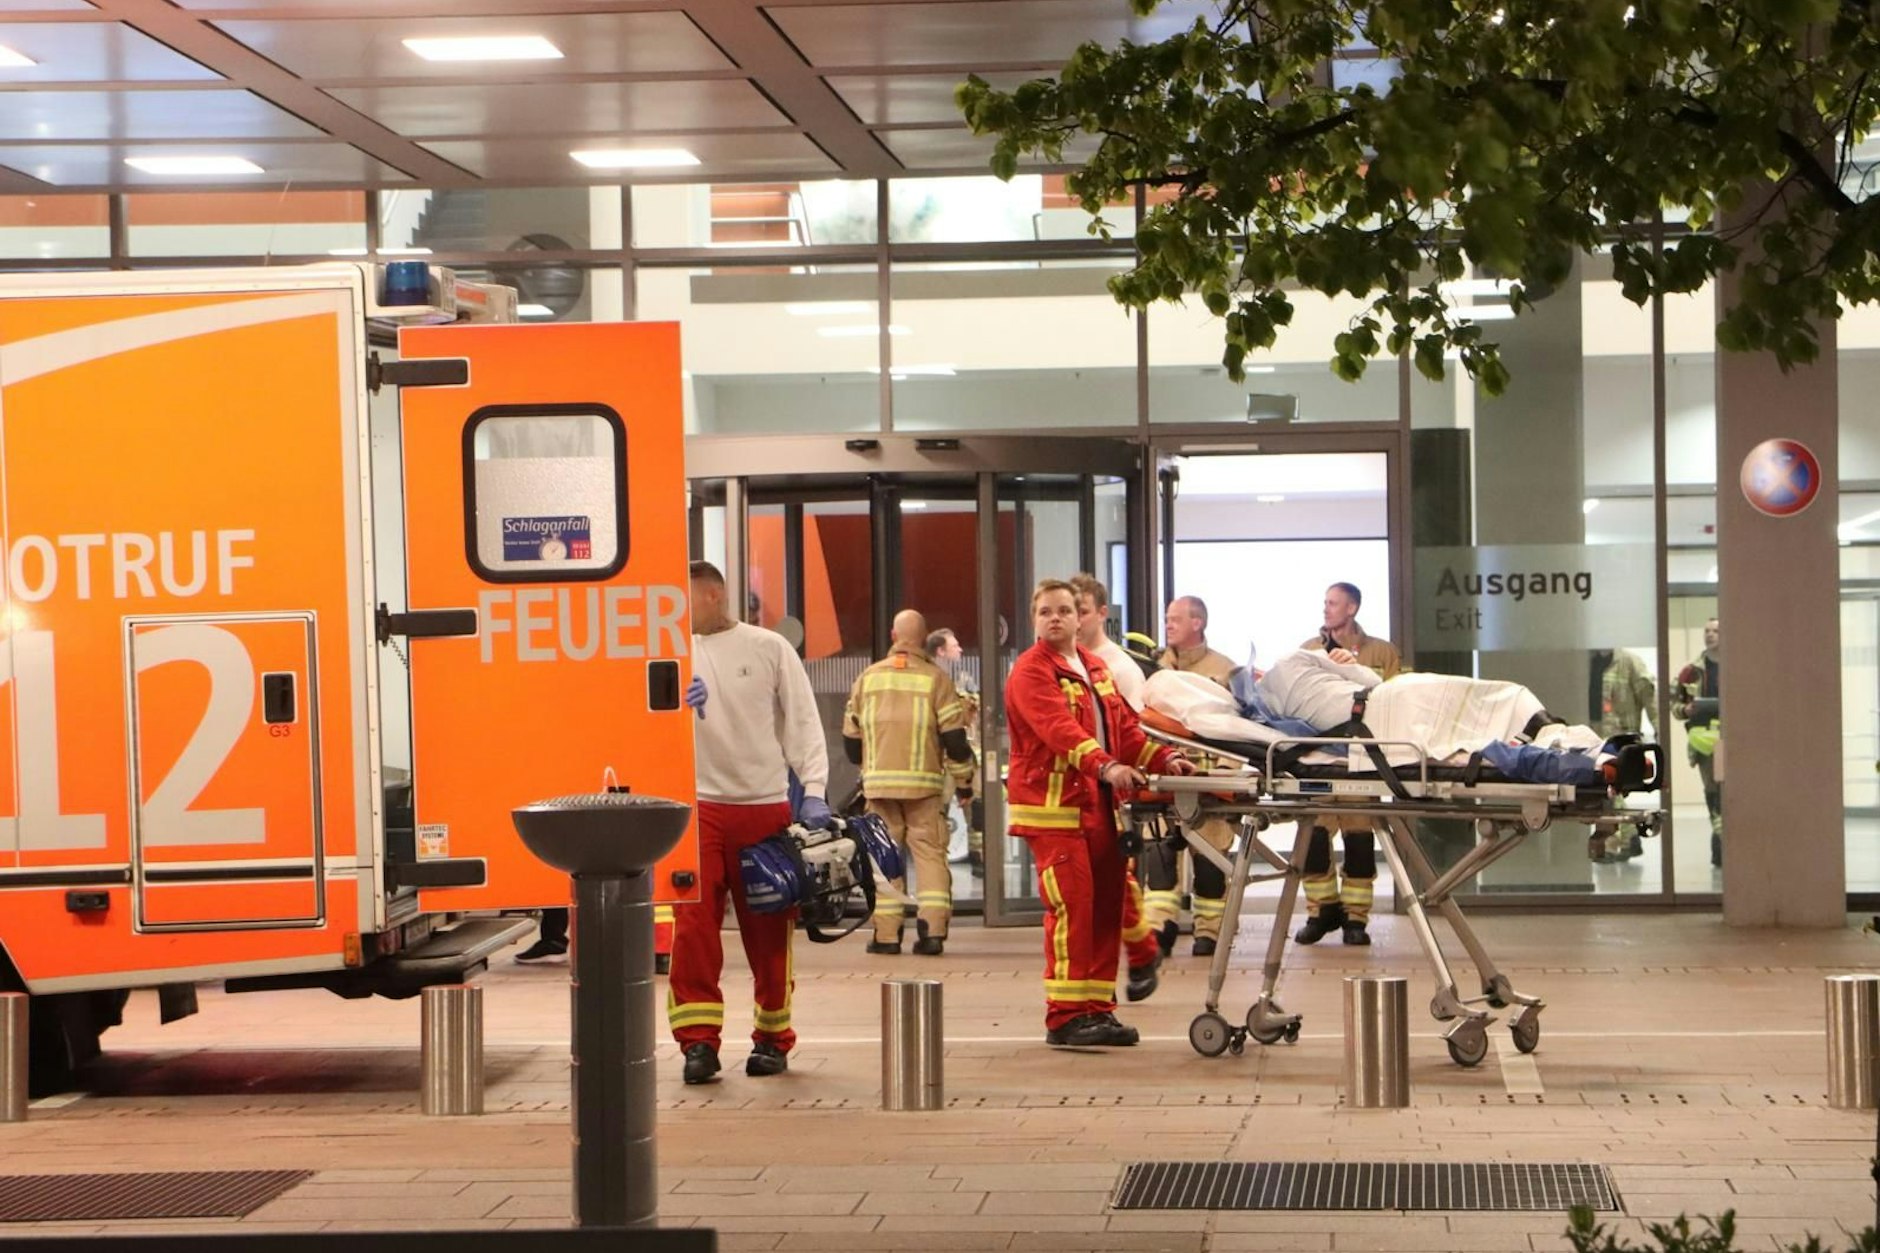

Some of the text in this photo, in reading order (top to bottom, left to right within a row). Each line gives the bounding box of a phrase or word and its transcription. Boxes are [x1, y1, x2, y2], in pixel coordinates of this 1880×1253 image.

[504, 517, 589, 535] Schlaganfall
[0, 529, 255, 603] OTRUF
[1436, 568, 1592, 601] Ausgang
[479, 585, 687, 663] FEUER
[1435, 608, 1483, 631] Exit
[269, 725, 291, 738] G3
